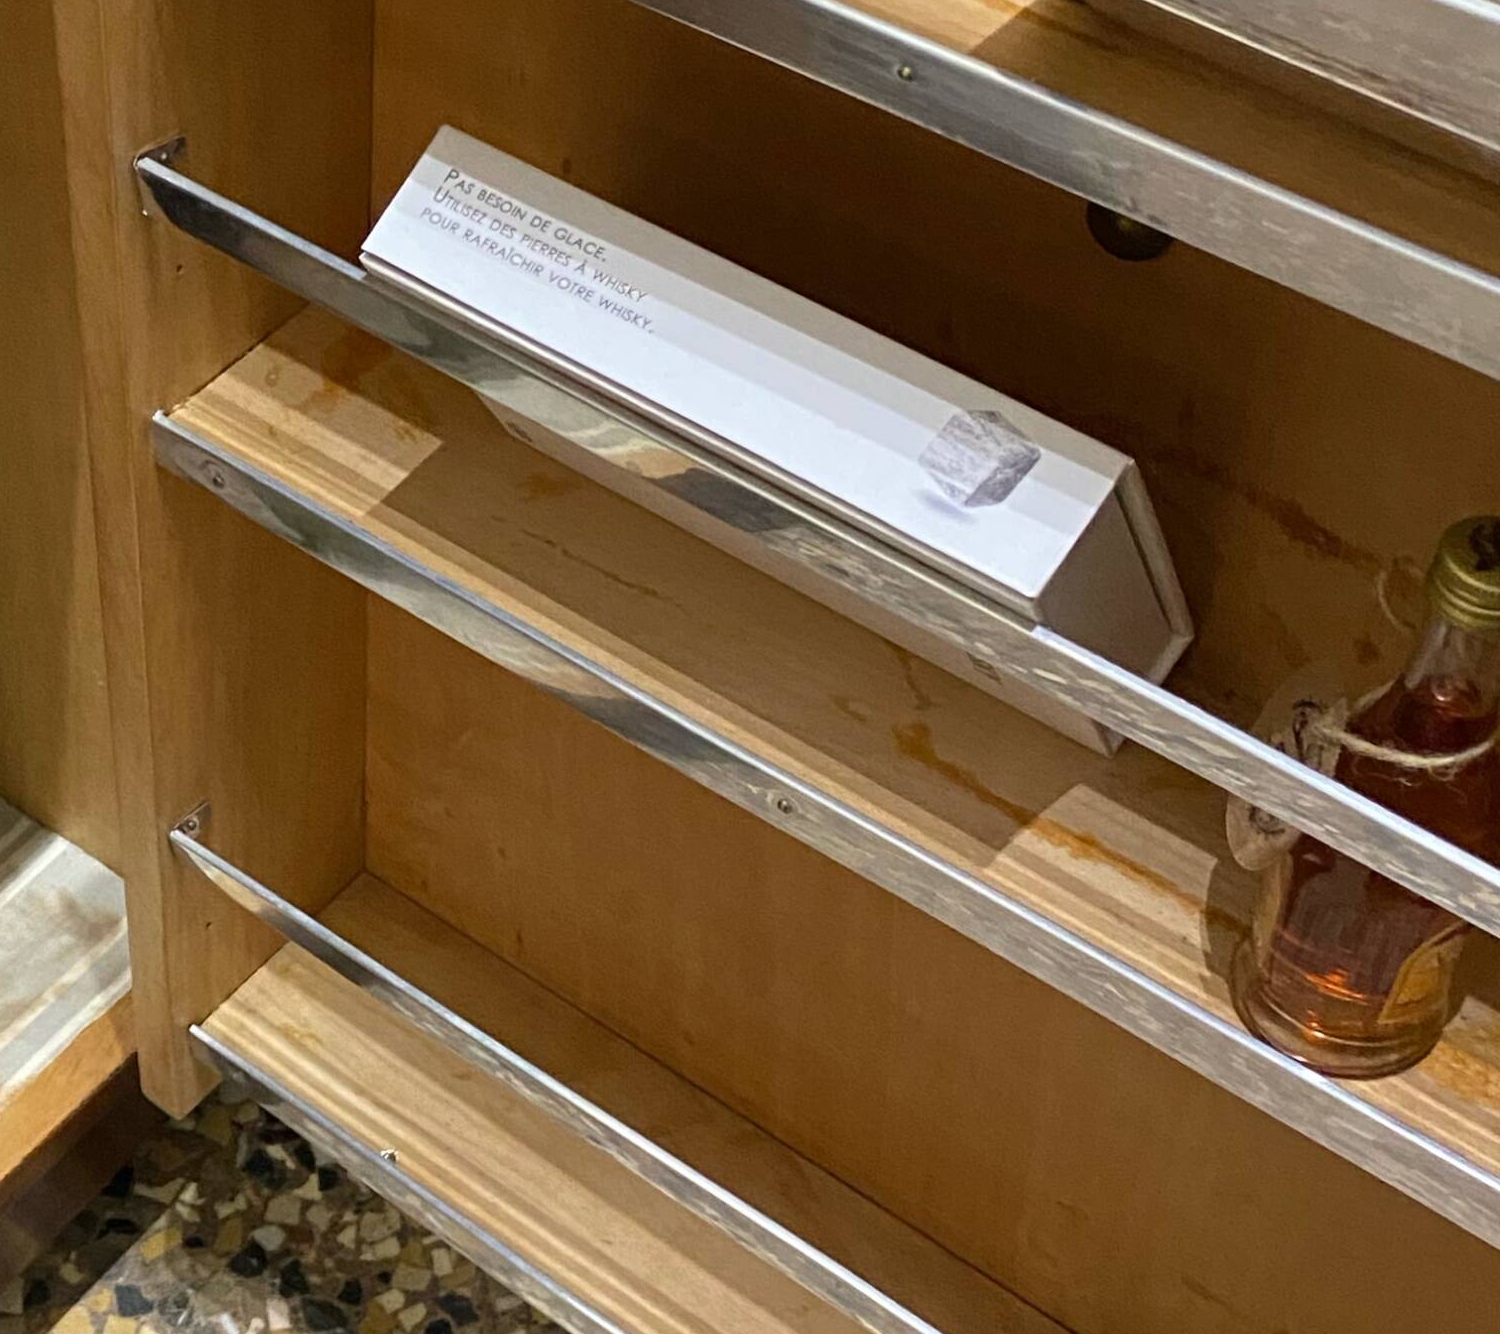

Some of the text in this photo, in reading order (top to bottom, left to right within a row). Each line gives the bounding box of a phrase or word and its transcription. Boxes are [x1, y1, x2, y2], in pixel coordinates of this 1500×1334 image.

[420, 207, 656, 335] POUR RAFRAÎCHIR VOTRE WHISKY.
[432, 187, 650, 303] UTILISEZ DES PIERRES À WHISKY
[444, 168, 607, 262] PAS BESOIN DE GLACE.
